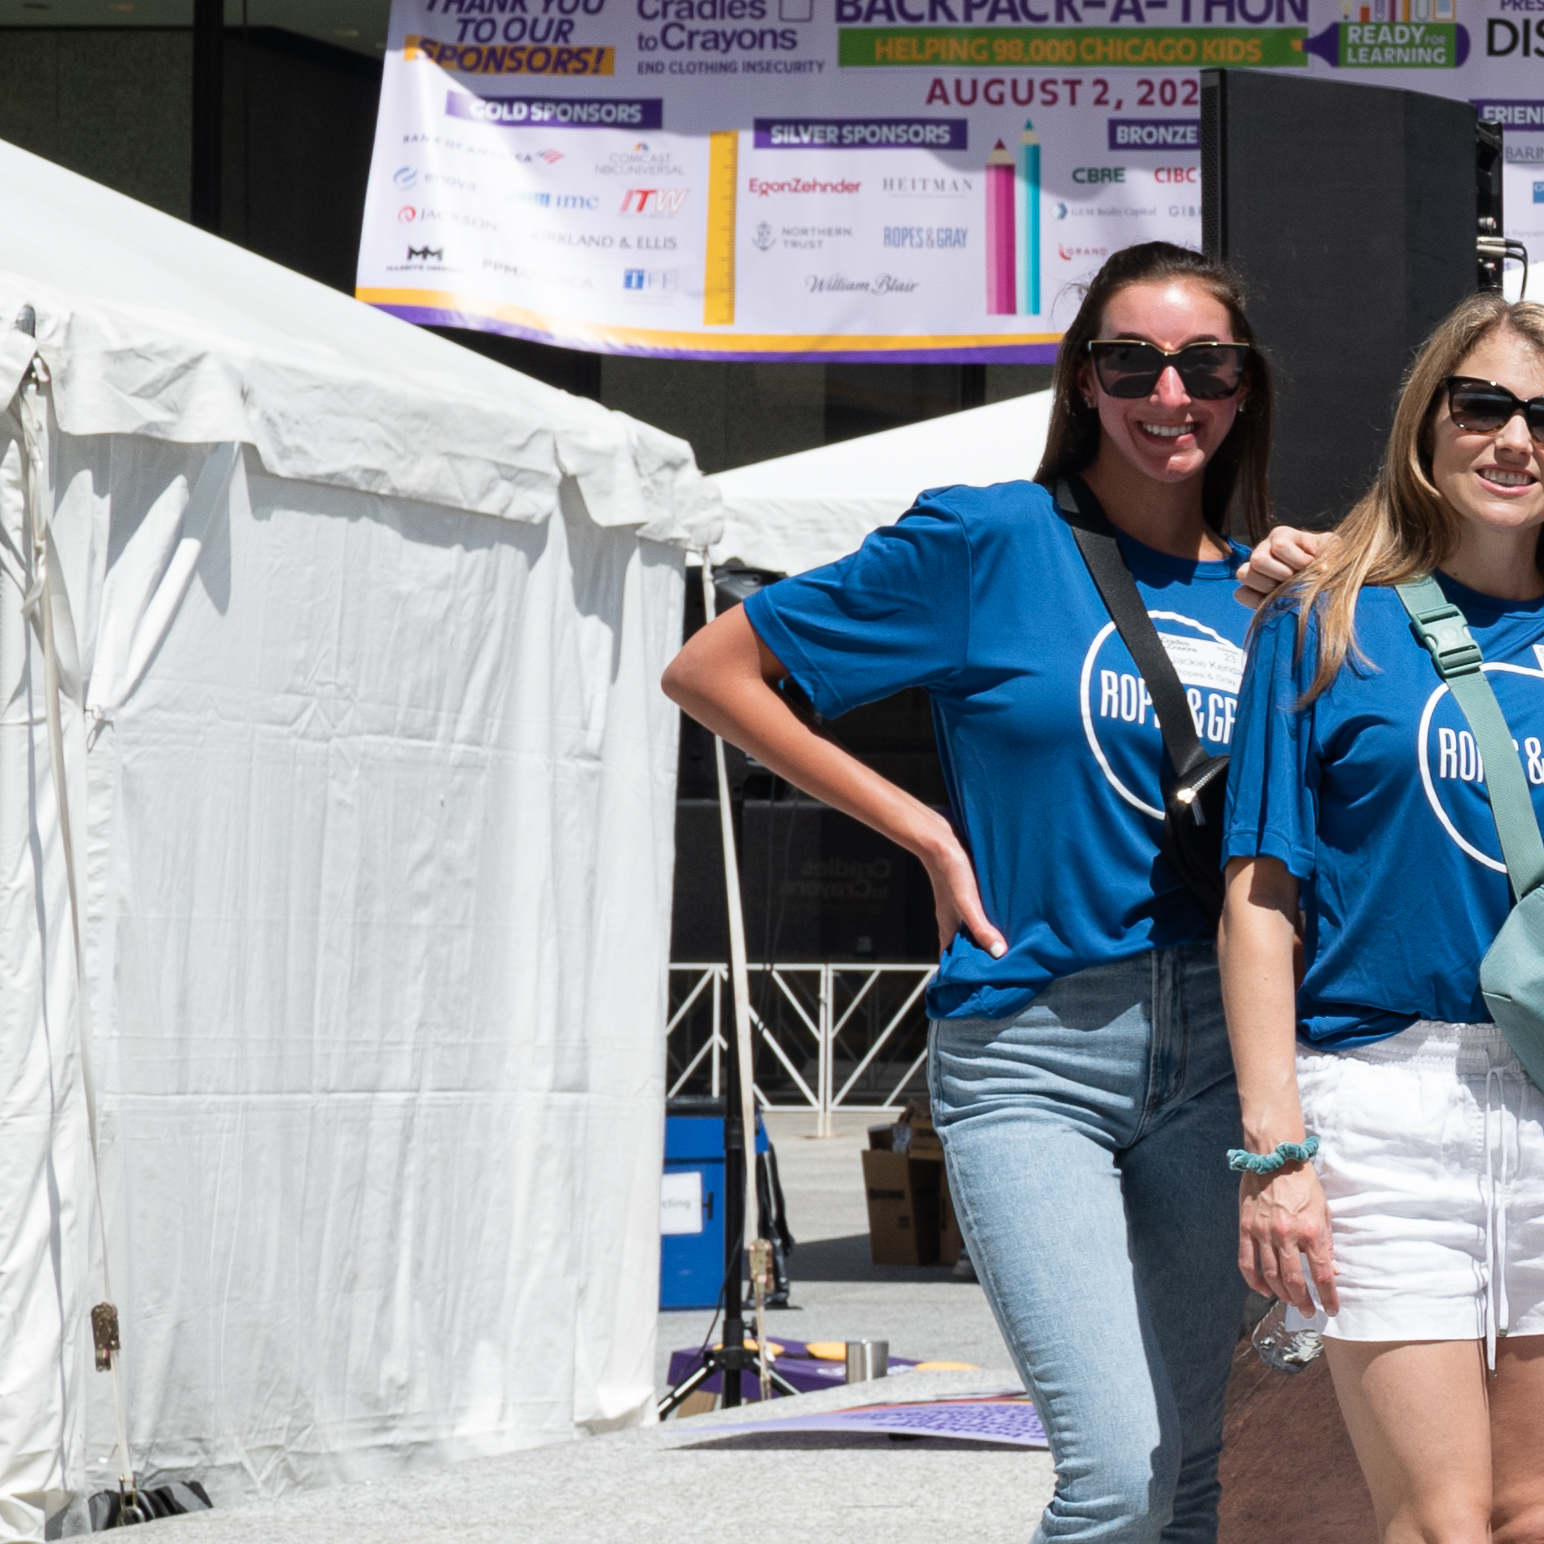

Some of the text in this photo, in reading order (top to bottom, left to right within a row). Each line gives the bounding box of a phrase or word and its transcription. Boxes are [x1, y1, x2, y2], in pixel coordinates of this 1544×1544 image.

[456, 18, 575, 44] TO OUR
[637, 22, 798, 54] to Crayons
[1347, 24, 1447, 45] READY FOR
[416, 38, 606, 74] SPONSORS!
[874, 37, 988, 62] HELPING
[1080, 38, 1198, 62] CHICAGO
[1201, 38, 1262, 62] KIDS
[1347, 47, 1446, 64] LEARNING
[637, 60, 825, 75] END CLOTHING INSECURITY
[926, 78, 1199, 112] AUGUST 2, 202
[469, 101, 642, 123] GOLD SPONSORS
[771, 124, 951, 144] SILVER SPONSORS
[1116, 125, 1198, 144] BRONZE
[609, 153, 672, 164] COMCAST
[594, 164, 684, 175] NBCUNIVERSAL
[1072, 167, 1126, 183] CBRE
[1154, 166, 1196, 183] CIBC
[749, 178, 861, 197] EgonZehnder
[883, 177, 973, 192] HEITMAN
[619, 188, 690, 213] ITW
[420, 208, 497, 232] JACKSON
[782, 227, 852, 237] NORTHERN
[884, 226, 923, 248] ROPES
[937, 227, 968, 248] GRAY
[619, 236, 631, 249] &
[637, 236, 678, 250] ELLIS
[783, 239, 824, 249] TRUST
[805, 273, 919, 295] William Blair
